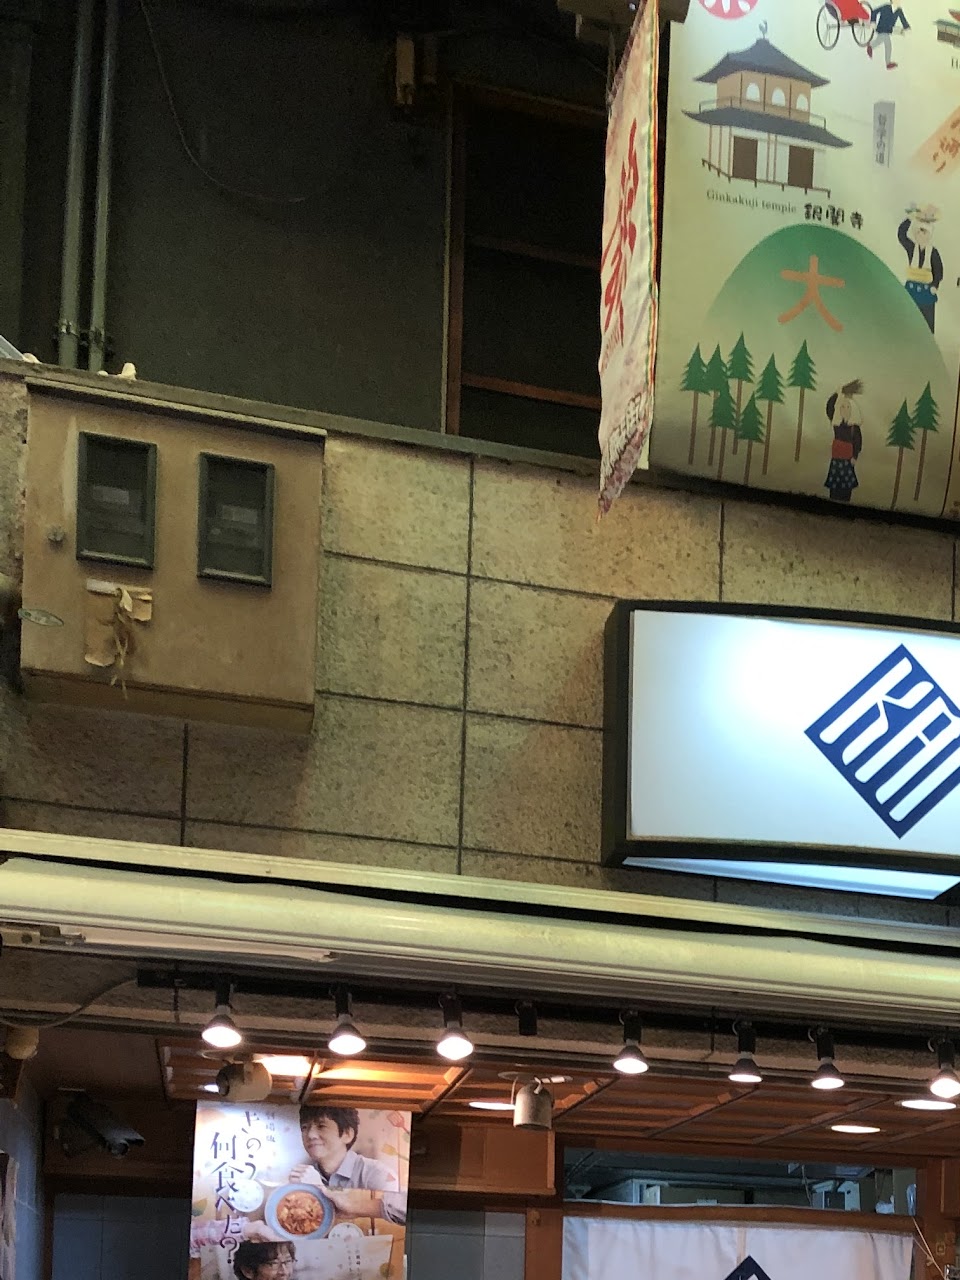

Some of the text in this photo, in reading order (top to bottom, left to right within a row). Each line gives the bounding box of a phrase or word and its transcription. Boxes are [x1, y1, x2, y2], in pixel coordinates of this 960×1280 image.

[706, 188, 797, 216] Ginkakuji temple
[780, 254, 845, 333] 大
[210, 1131, 245, 1264] 何食べた？
